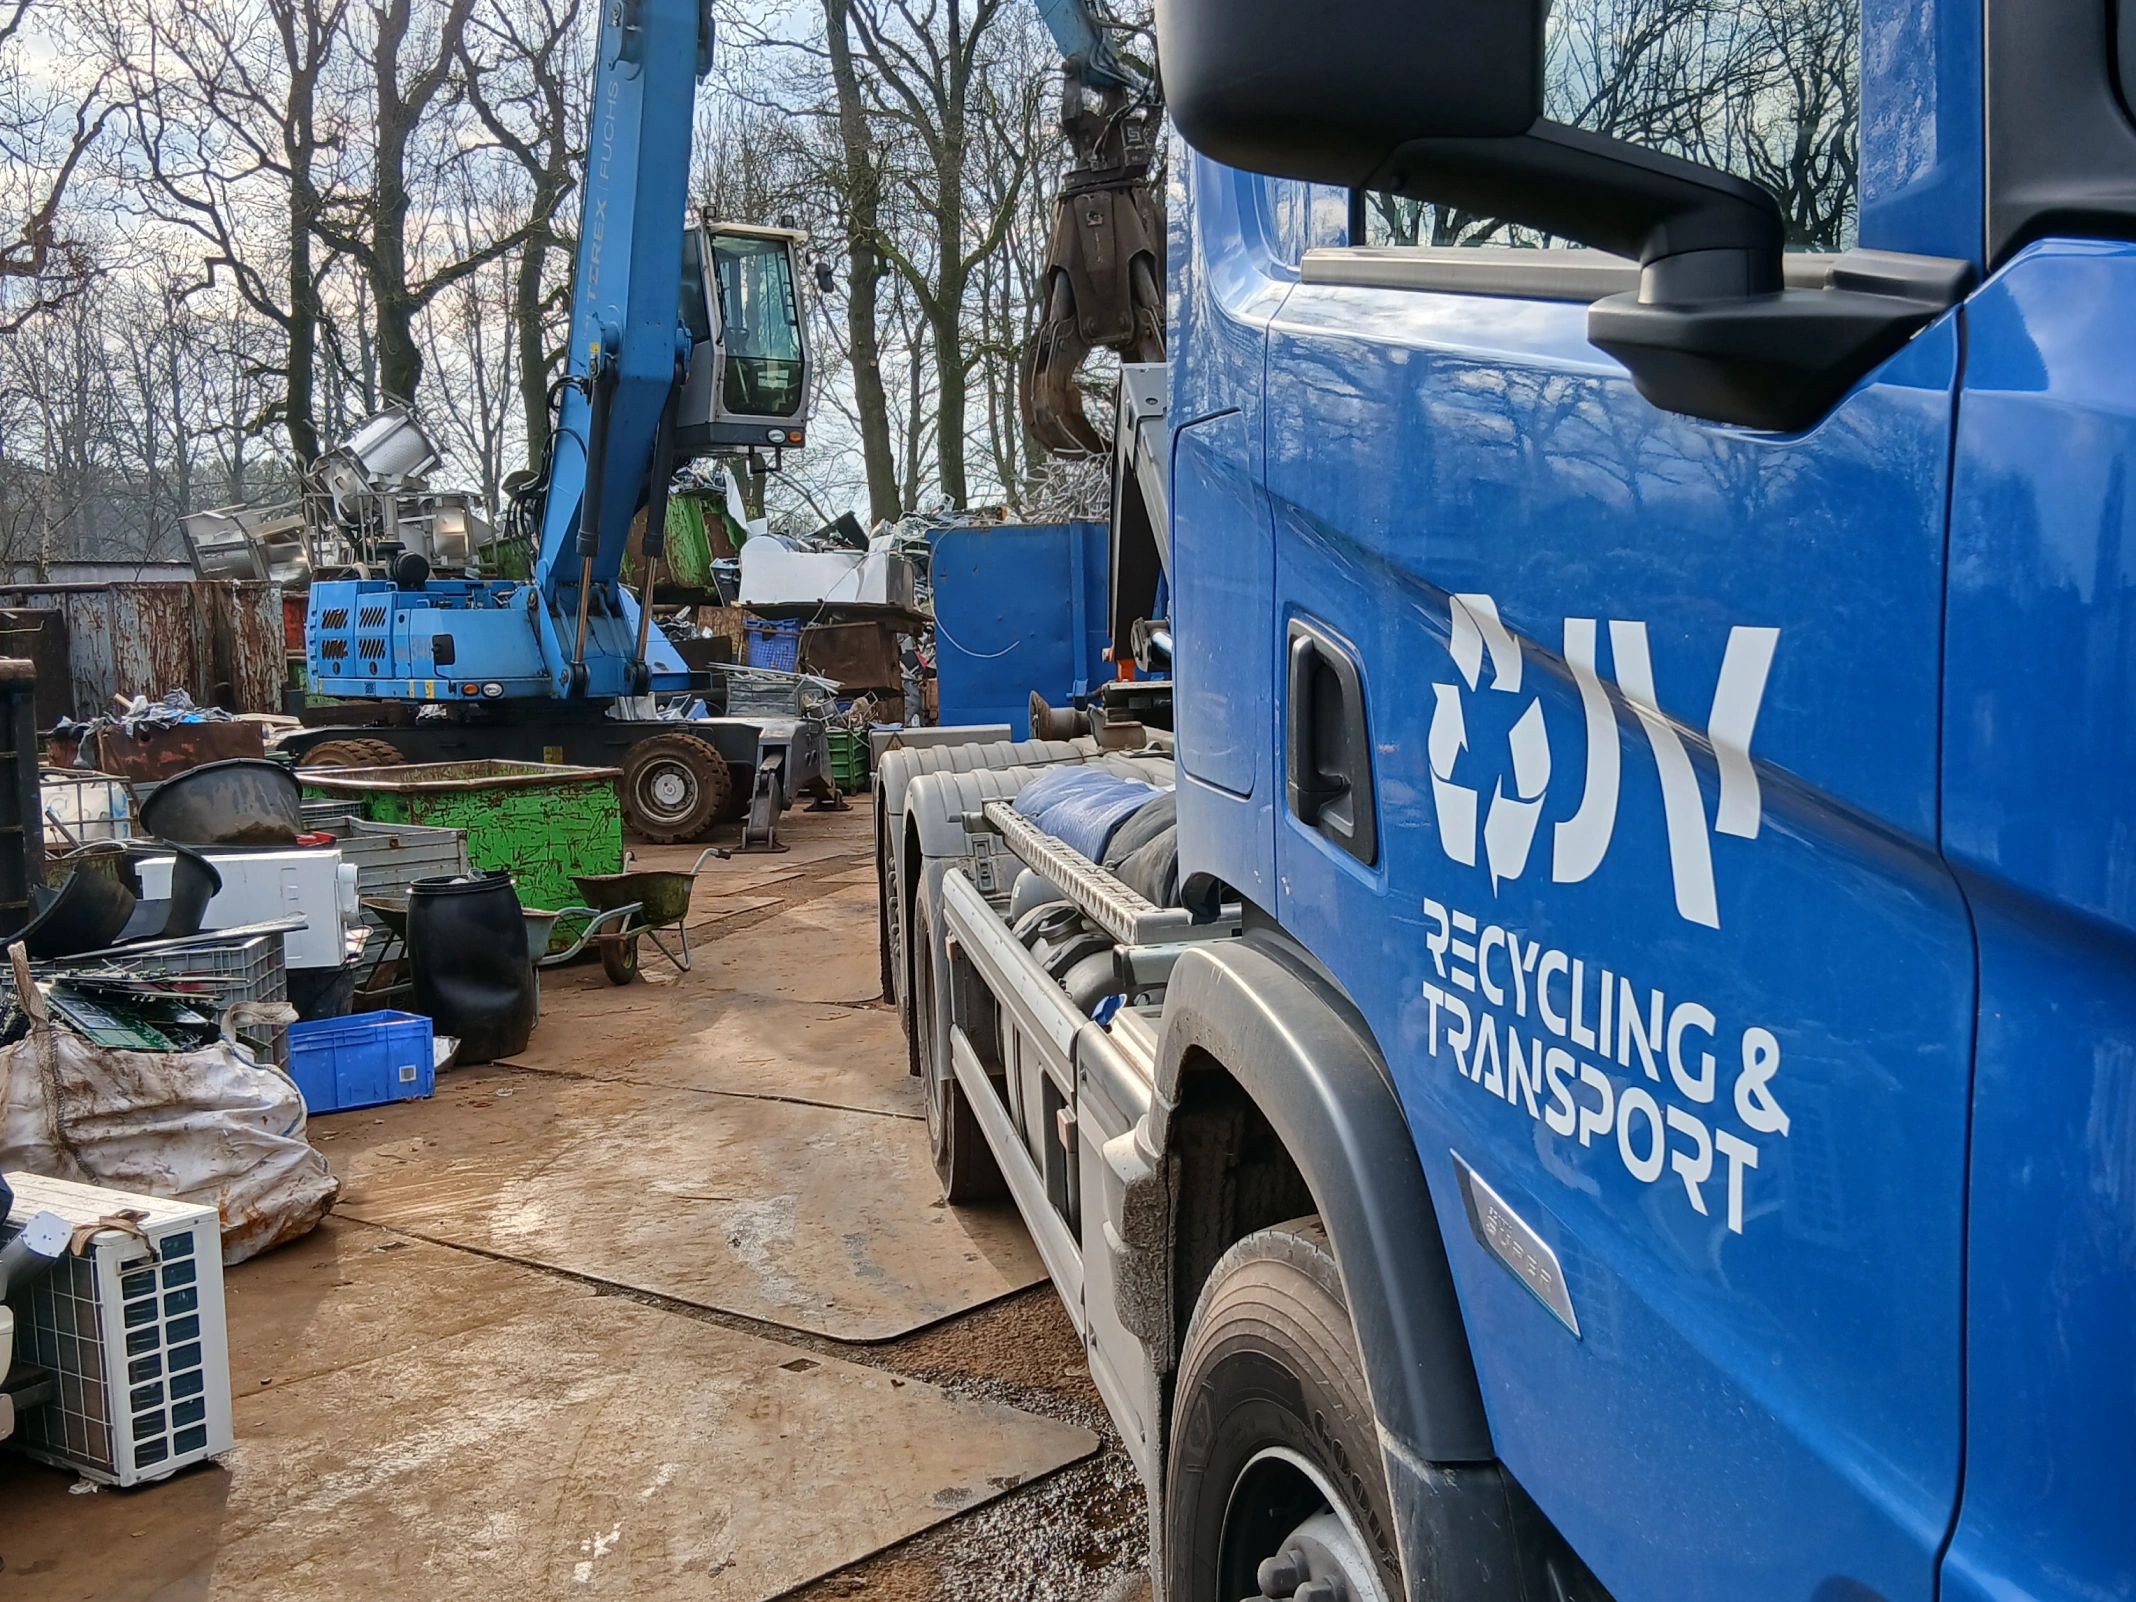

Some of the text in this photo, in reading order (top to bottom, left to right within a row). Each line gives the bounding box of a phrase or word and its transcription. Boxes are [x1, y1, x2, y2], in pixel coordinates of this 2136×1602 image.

[587, 198, 608, 301] TEREX
[600, 80, 619, 180] FUCHS
[1422, 980, 1759, 1235] TRANSPORT
[1423, 897, 1791, 1138] RECYCLING &
[1485, 1215, 1552, 1292] SUPER
